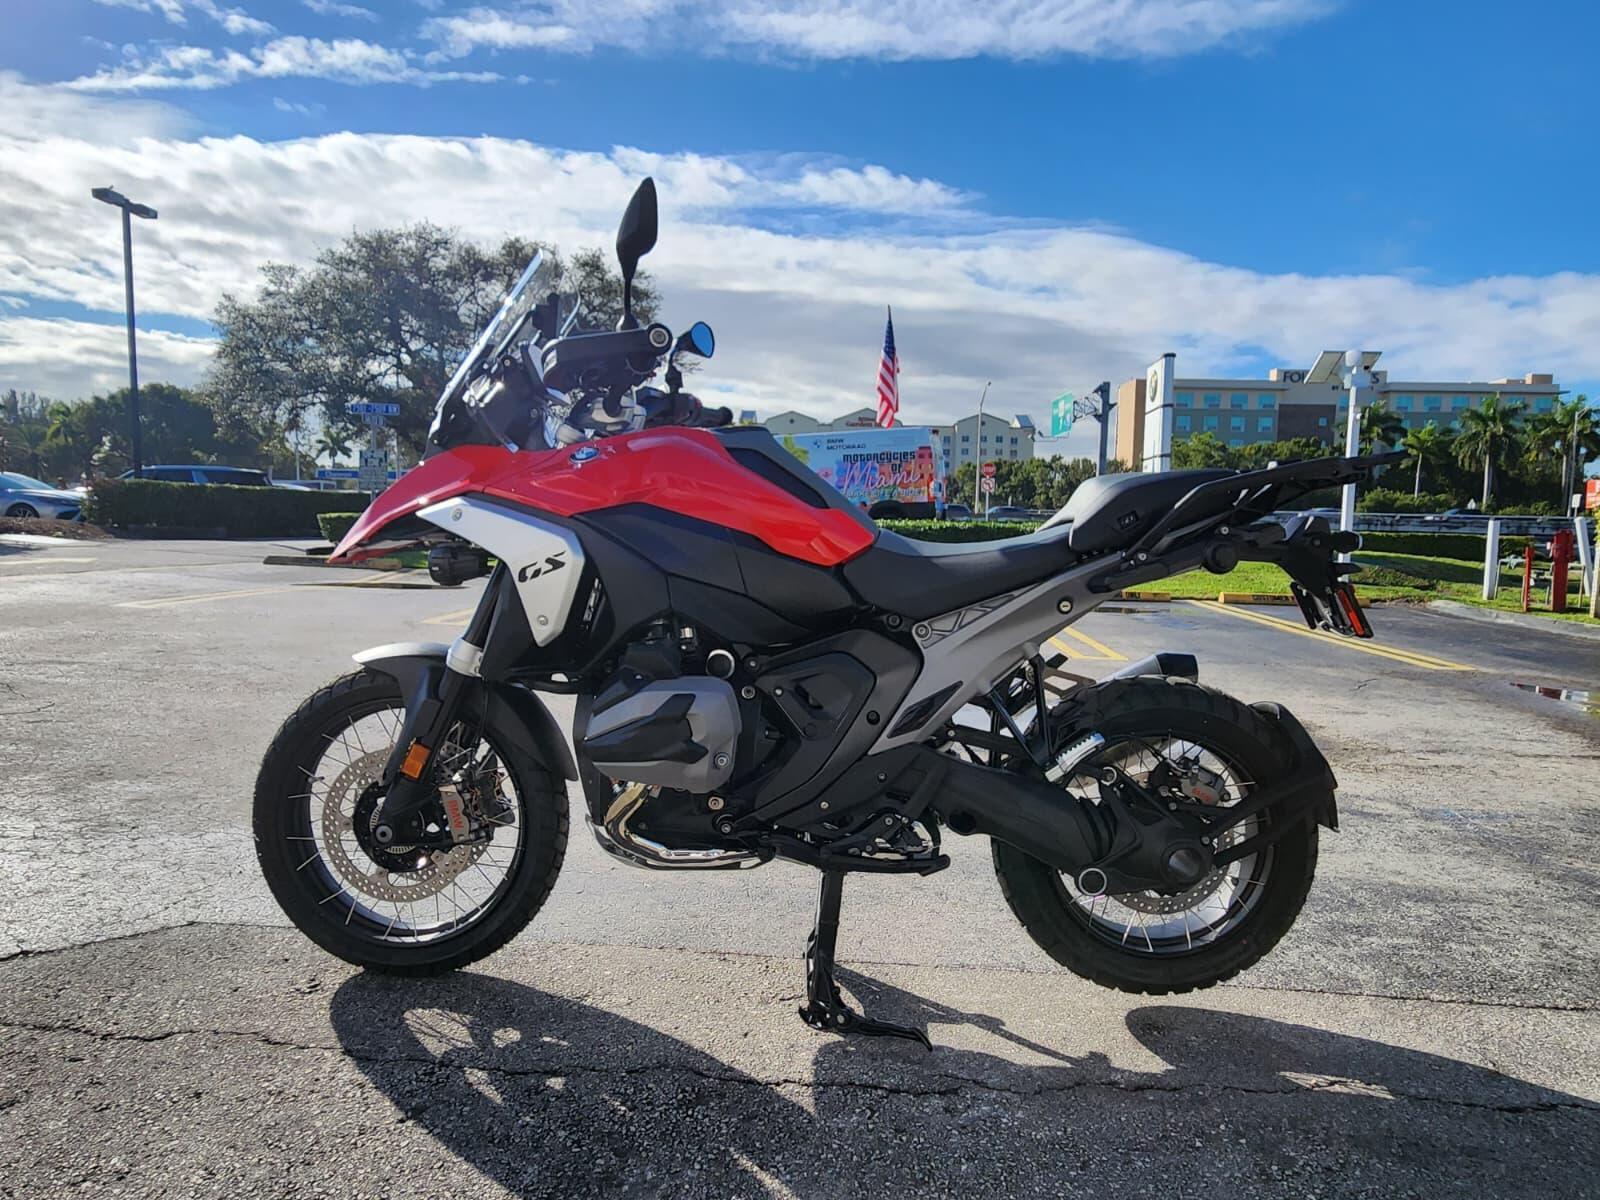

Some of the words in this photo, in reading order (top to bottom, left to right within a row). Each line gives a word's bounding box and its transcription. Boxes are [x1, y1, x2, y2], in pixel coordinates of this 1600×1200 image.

[842, 459, 921, 496] Miami
[518, 550, 566, 583] GS
[447, 799, 465, 830] BMW
